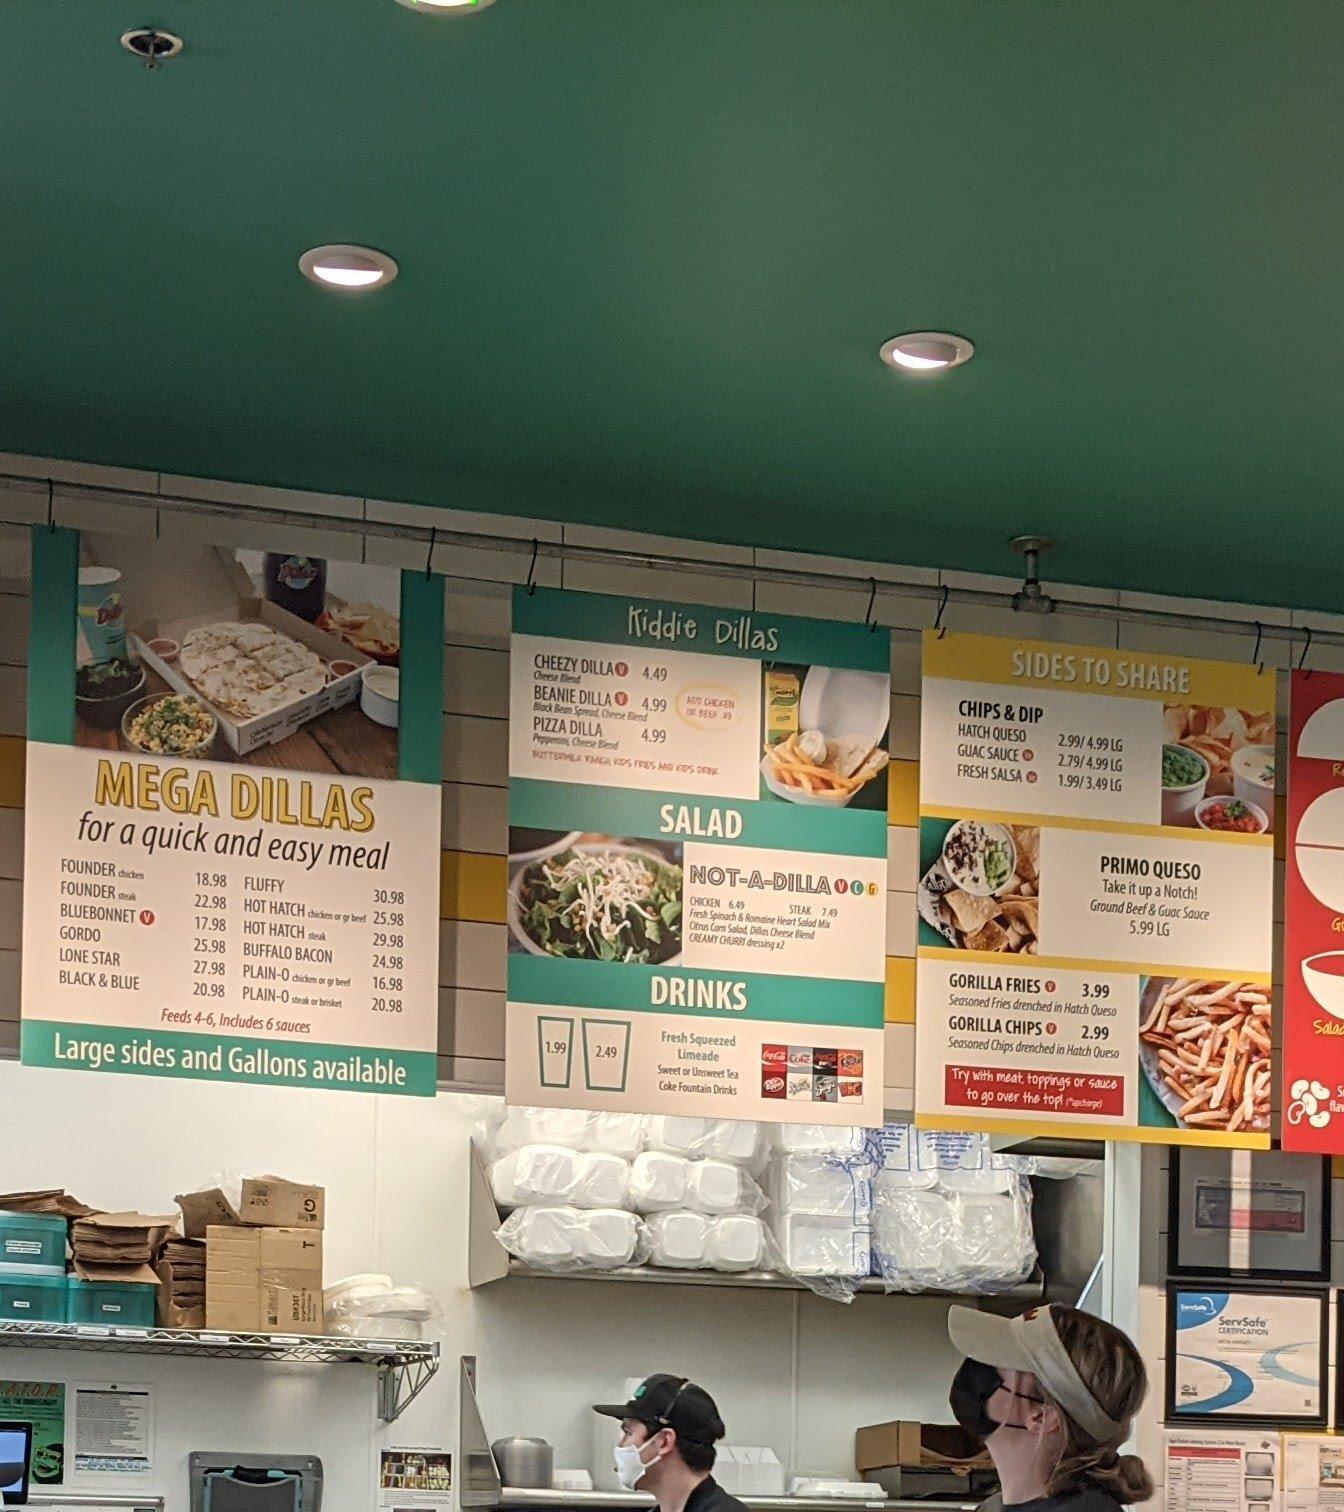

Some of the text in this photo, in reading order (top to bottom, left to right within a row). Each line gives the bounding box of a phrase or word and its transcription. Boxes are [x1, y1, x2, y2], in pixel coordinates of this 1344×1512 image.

[628, 606, 778, 651] Kiddie Dillas
[534, 654, 667, 682] CHEEZY DILLA 4.49
[1011, 650, 1190, 695] SIDES TO SHARE
[534, 686, 667, 712] BEANIE DILLA 4.99
[959, 700, 1043, 723] CHIPS & DIP
[958, 724, 1026, 742] HATCH QUESO
[958, 744, 1019, 762] GUAC SAUCE
[957, 764, 1022, 782] FRESH SALSA
[95, 759, 374, 833] MEGA DILLAS
[659, 804, 743, 839] SALAD
[78, 811, 390, 871] for a quick and easy meal
[61, 858, 227, 888] FOUNDER 18.98
[690, 865, 831, 896] NOT-A-DILLA
[1100, 856, 1201, 879] PRIMO QUESO
[244, 876, 404, 905] FLUFFY 30.98
[1103, 879, 1198, 900] Take it up a Notch!
[61, 904, 226, 932] BLUEBONNET 17.98
[244, 899, 404, 926] HOT HATCH 25.98
[60, 926, 225, 954] GORDO 25.98
[60, 949, 225, 976] LONE STAR 27.98
[244, 943, 403, 970] BUFFALO BACON 24.98
[59, 970, 225, 998] BLACK & BLUE 20.98
[651, 976, 748, 1010] DRINKS
[949, 973, 1110, 998] GORILLA FRIES 3.99
[545, 1041, 567, 1055] 1.99
[595, 1045, 617, 1058] 2.49
[661, 1031, 736, 1047] Fresh Squeezed
[55, 1033, 406, 1086] Large sides and Gallons available
[677, 1049, 720, 1062] Limeade
[1219, 1317, 1266, 1327] ServSafe
